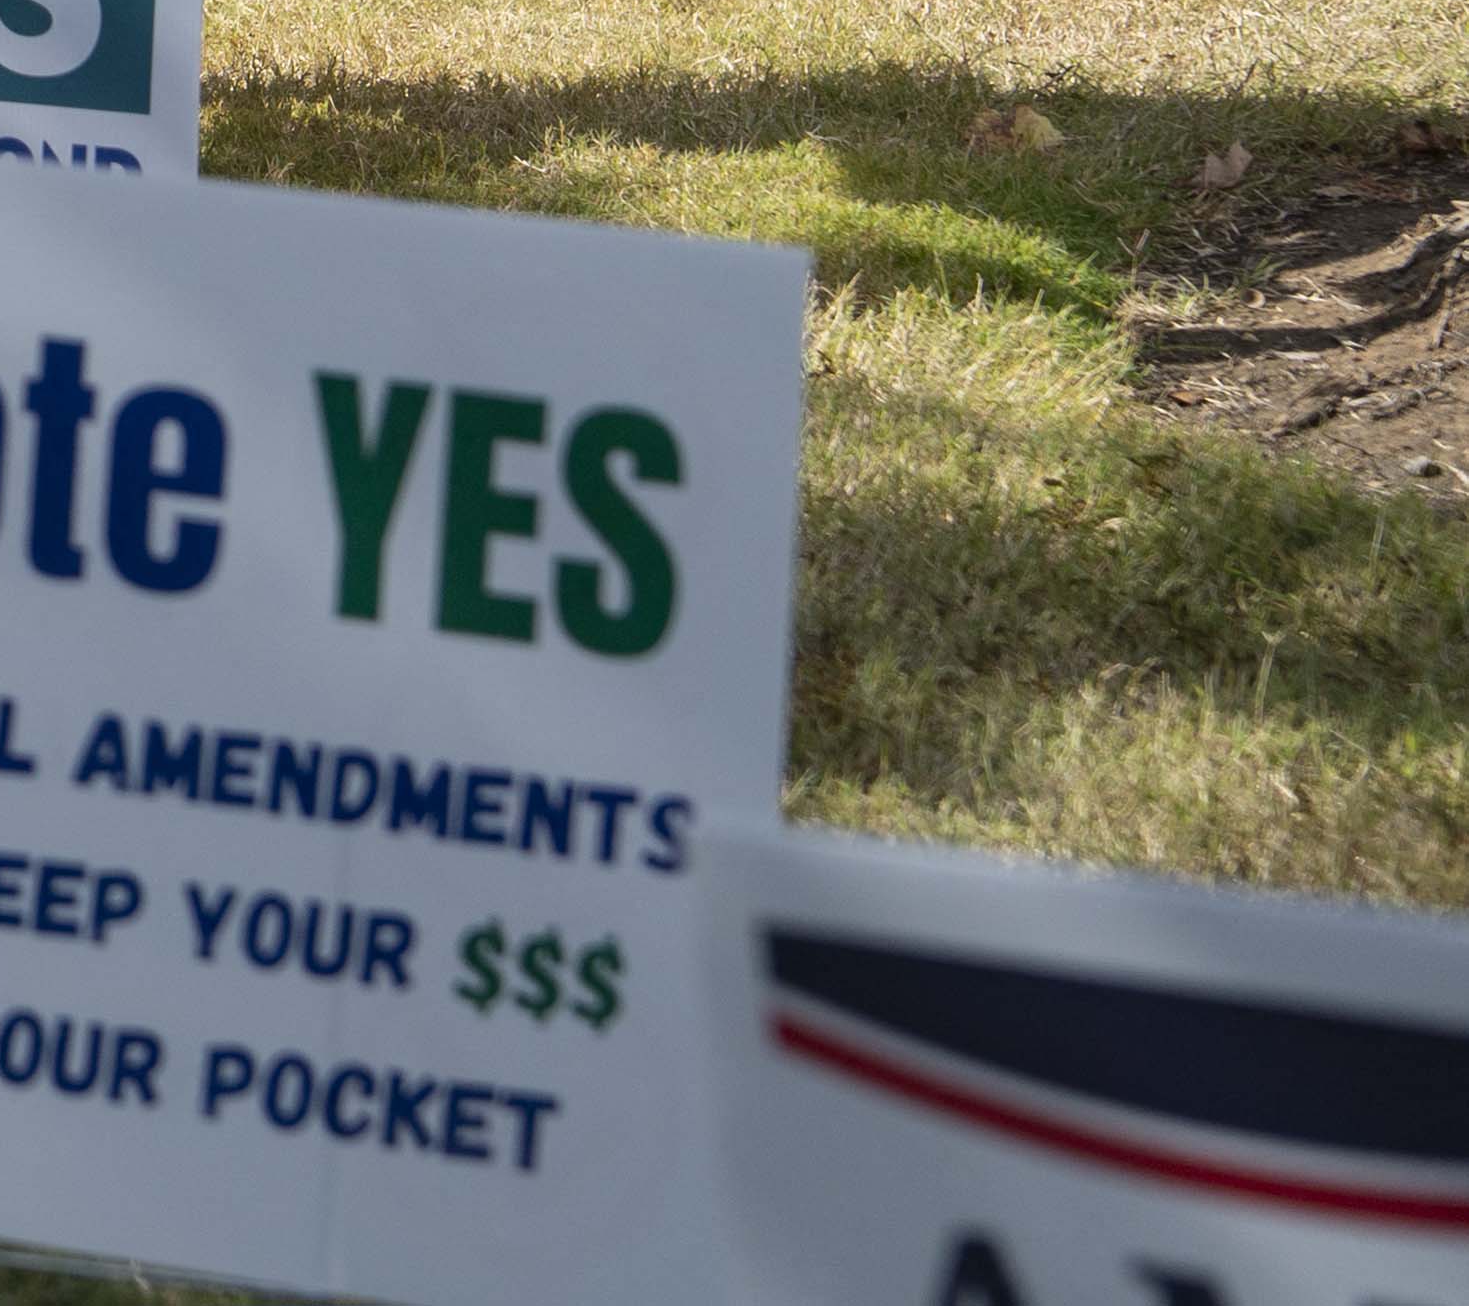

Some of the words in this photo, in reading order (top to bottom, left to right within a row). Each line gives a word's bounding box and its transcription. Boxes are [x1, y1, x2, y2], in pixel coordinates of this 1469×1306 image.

[315, 367, 685, 660] YES
[77, 713, 695, 875] AMENDMENTS
[182, 877, 420, 995] YOUR
[453, 916, 628, 1036] $$$
[199, 1044, 561, 1177] POCKET
